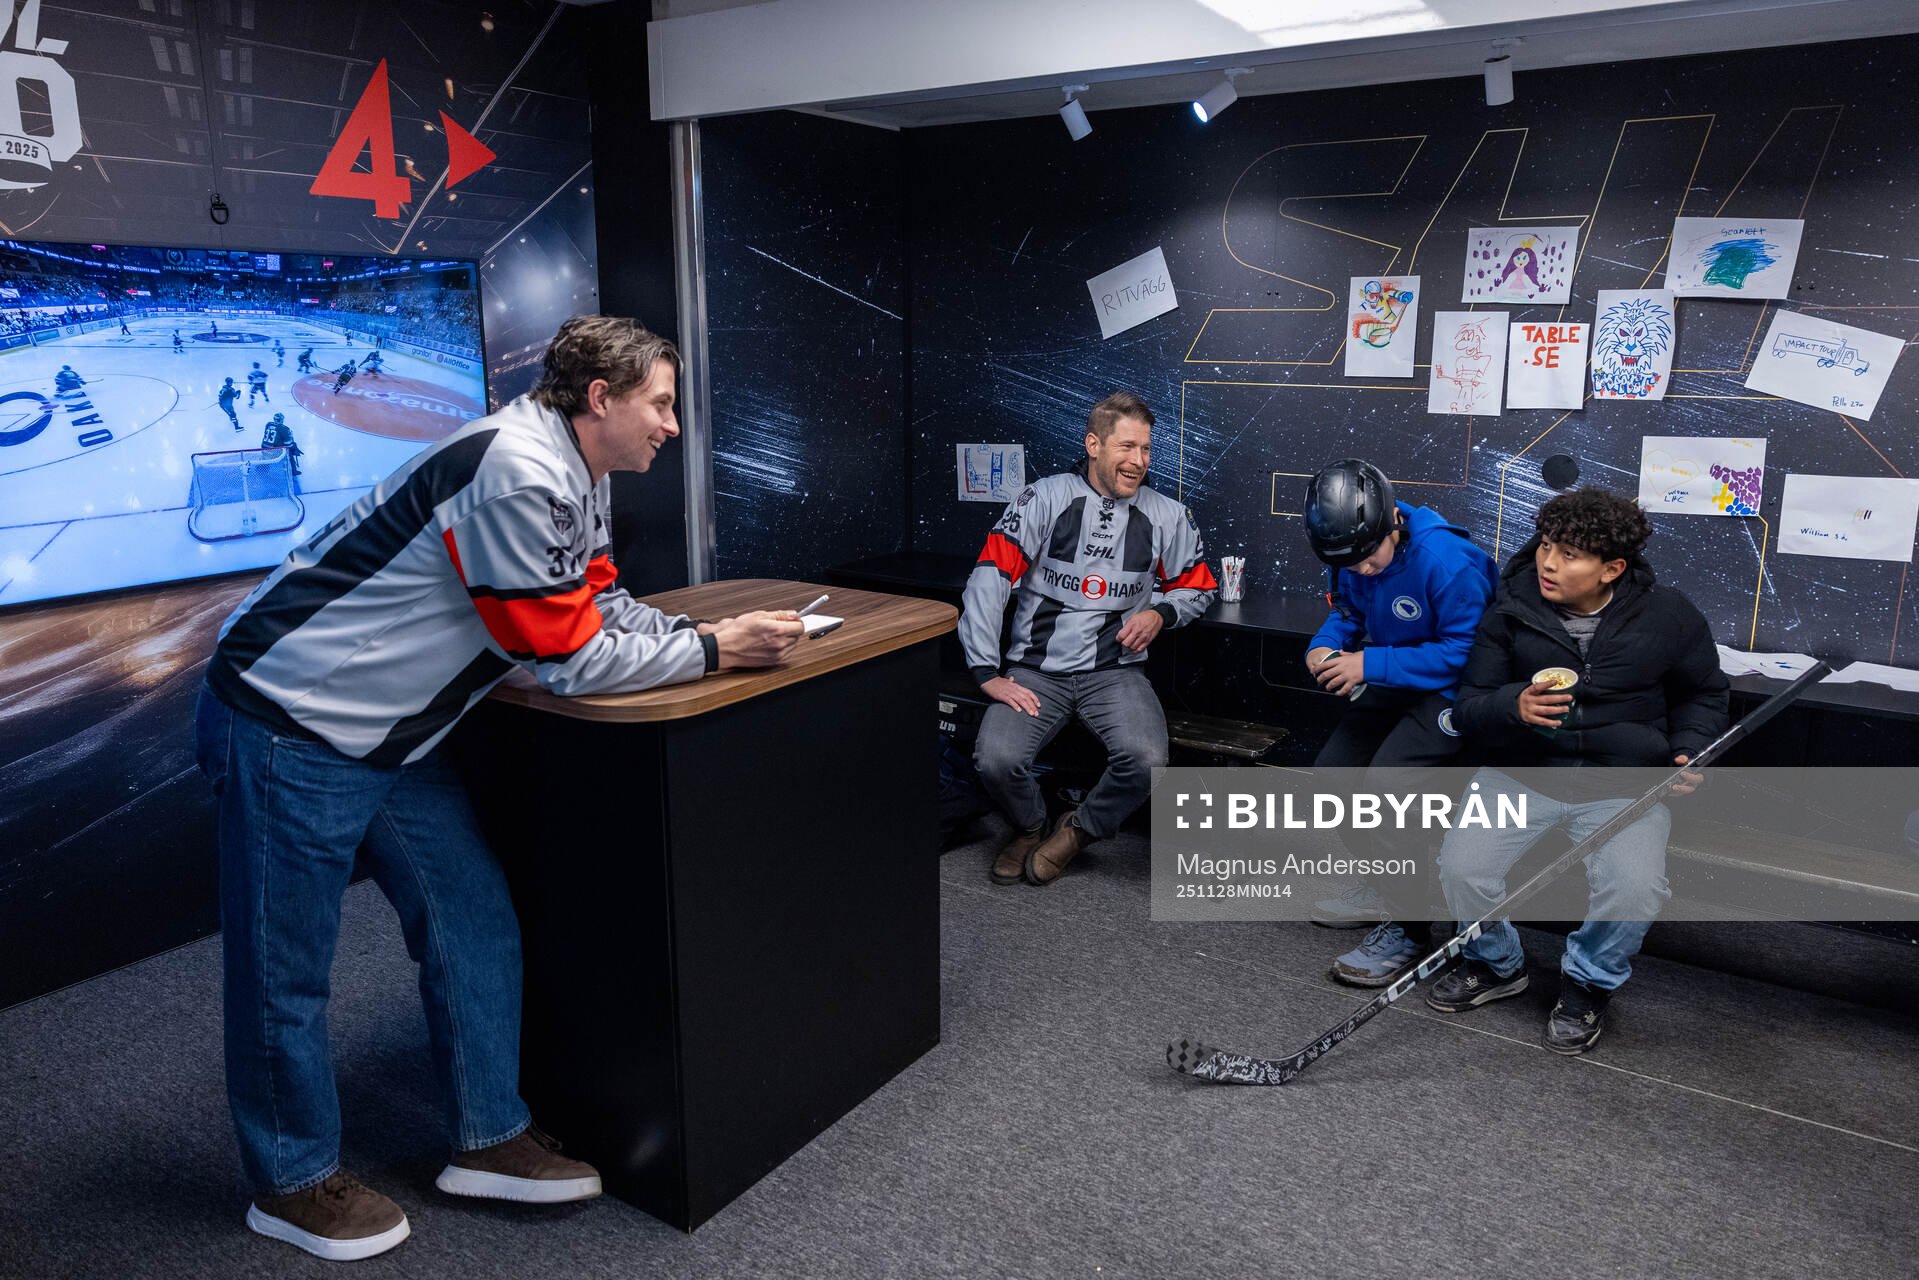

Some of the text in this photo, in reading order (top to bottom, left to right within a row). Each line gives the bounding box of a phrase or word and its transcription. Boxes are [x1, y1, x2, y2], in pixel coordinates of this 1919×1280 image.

[0, 0, 70, 55] L
[309, 57, 412, 219] 4
[5, 140, 39, 159] 2025
[1521, 325, 1581, 344] TABLE
[1523, 346, 1560, 368] .SE
[1784, 339, 1837, 357] IMPACT TOUR
[1083, 544, 1116, 560] SHL
[1041, 566, 1081, 592] TRYGG
[1388, 921, 1481, 1002] CCM
